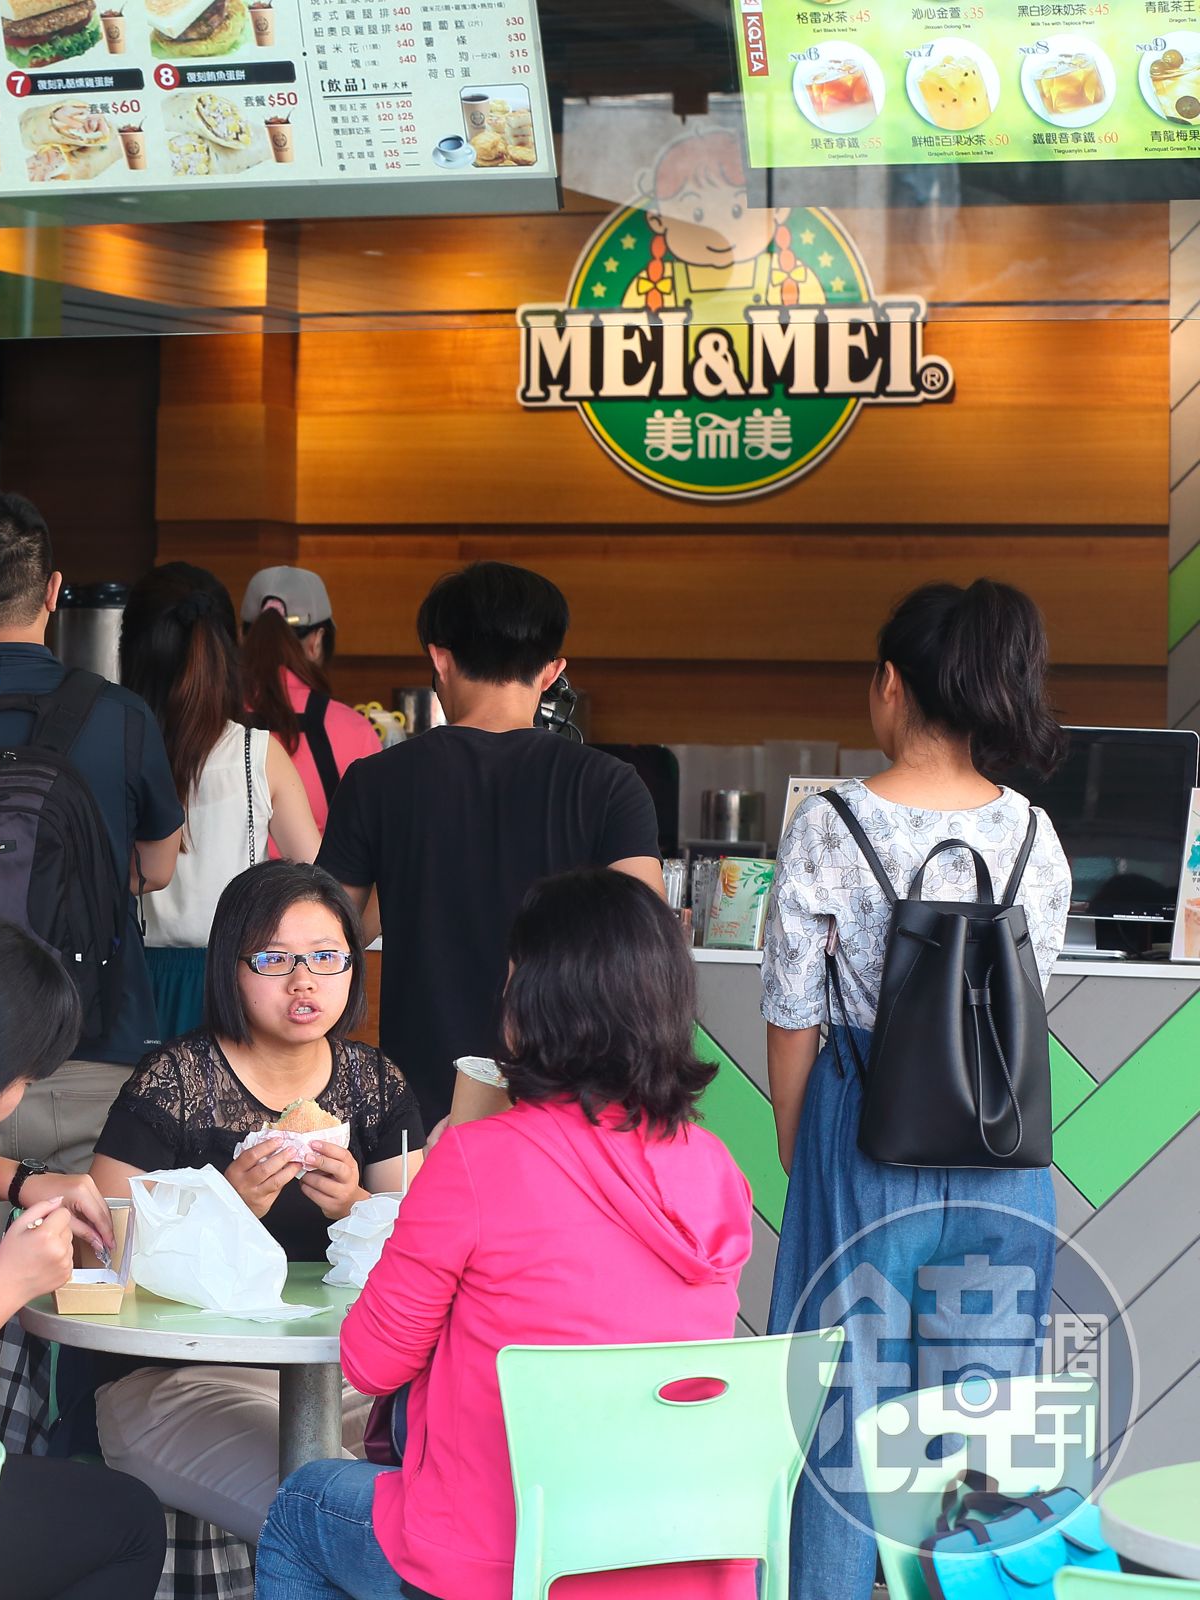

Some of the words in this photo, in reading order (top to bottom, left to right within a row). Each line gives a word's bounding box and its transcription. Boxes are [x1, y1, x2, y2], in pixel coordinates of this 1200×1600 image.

[393, 6, 411, 16] $40
[1017, 4, 1087, 17] 黑白珍珠奶茶
[1145, 0, 1196, 13] 青龍茶王
[796, 10, 848, 24] 格雷冰茶
[912, 7, 960, 20] 沁心金萱
[505, 16, 524, 26] $30
[395, 22, 413, 32] $40
[507, 32, 526, 42] $30
[397, 38, 415, 48] $40
[746, 15, 765, 73] KQTEA
[510, 48, 528, 58] $15
[399, 54, 417, 64] $40
[511, 64, 530, 74] $10
[160, 67, 175, 86] 8
[11, 75, 25, 94] 7
[372, 82, 388, 90] 中杯
[393, 81, 409, 89] 大杯
[244, 95, 266, 107] 套餐
[267, 92, 298, 107] $50
[89, 103, 110, 115] 套餐
[111, 99, 140, 114] $60
[376, 101, 392, 110] $15
[396, 100, 412, 109] $20
[378, 113, 394, 122] $20
[398, 112, 414, 121] $25
[400, 124, 416, 133] $40
[401, 136, 418, 145] $25
[811, 137, 860, 150] 果香拿鐵
[1032, 132, 1096, 145] 鐵觀音拿鐵
[383, 149, 400, 158] $35
[385, 161, 401, 170] $45
[524, 306, 918, 399] MEI&MEI
[644, 408, 793, 462] 美而美
